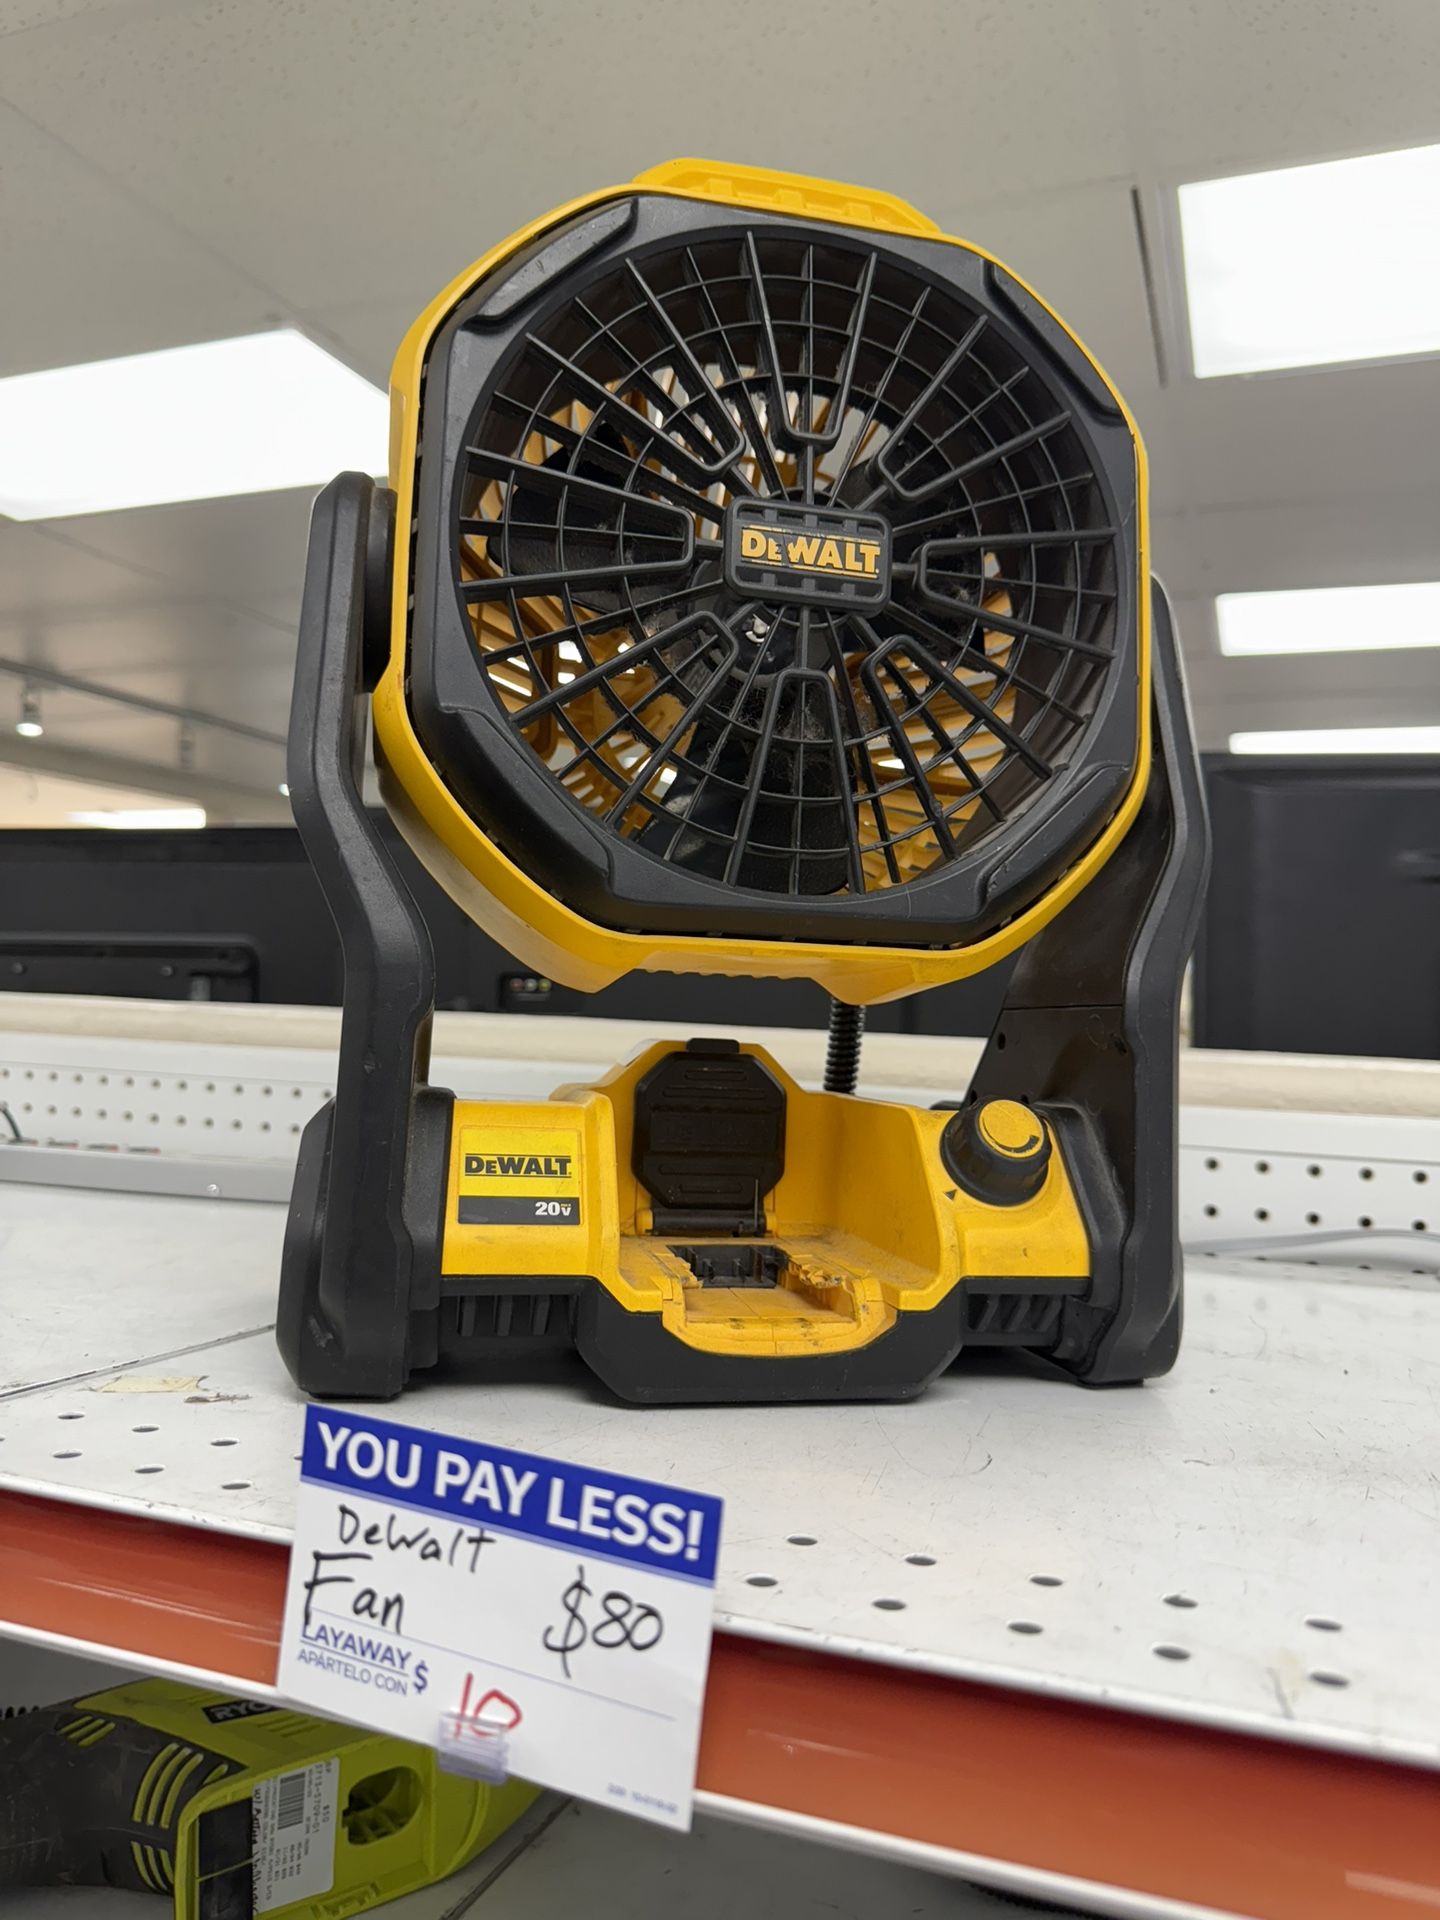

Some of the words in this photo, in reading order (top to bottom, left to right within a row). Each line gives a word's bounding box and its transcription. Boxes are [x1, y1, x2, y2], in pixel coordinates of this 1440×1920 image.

[741, 529, 880, 574] DEWALT
[464, 1155, 572, 1176] DEWALT
[317, 1421, 422, 1490] YOU
[434, 1449, 538, 1517] PAY
[546, 1478, 705, 1561] LESS!
[303, 1550, 405, 1635] Fan
[543, 1565, 664, 1679] $80
[301, 1622, 412, 1672] LAYAWAY
[414, 1659, 429, 1694] $
[374, 1670, 408, 1697] CON
[209, 1700, 272, 1721] RYO
[453, 1673, 523, 1740] 10
